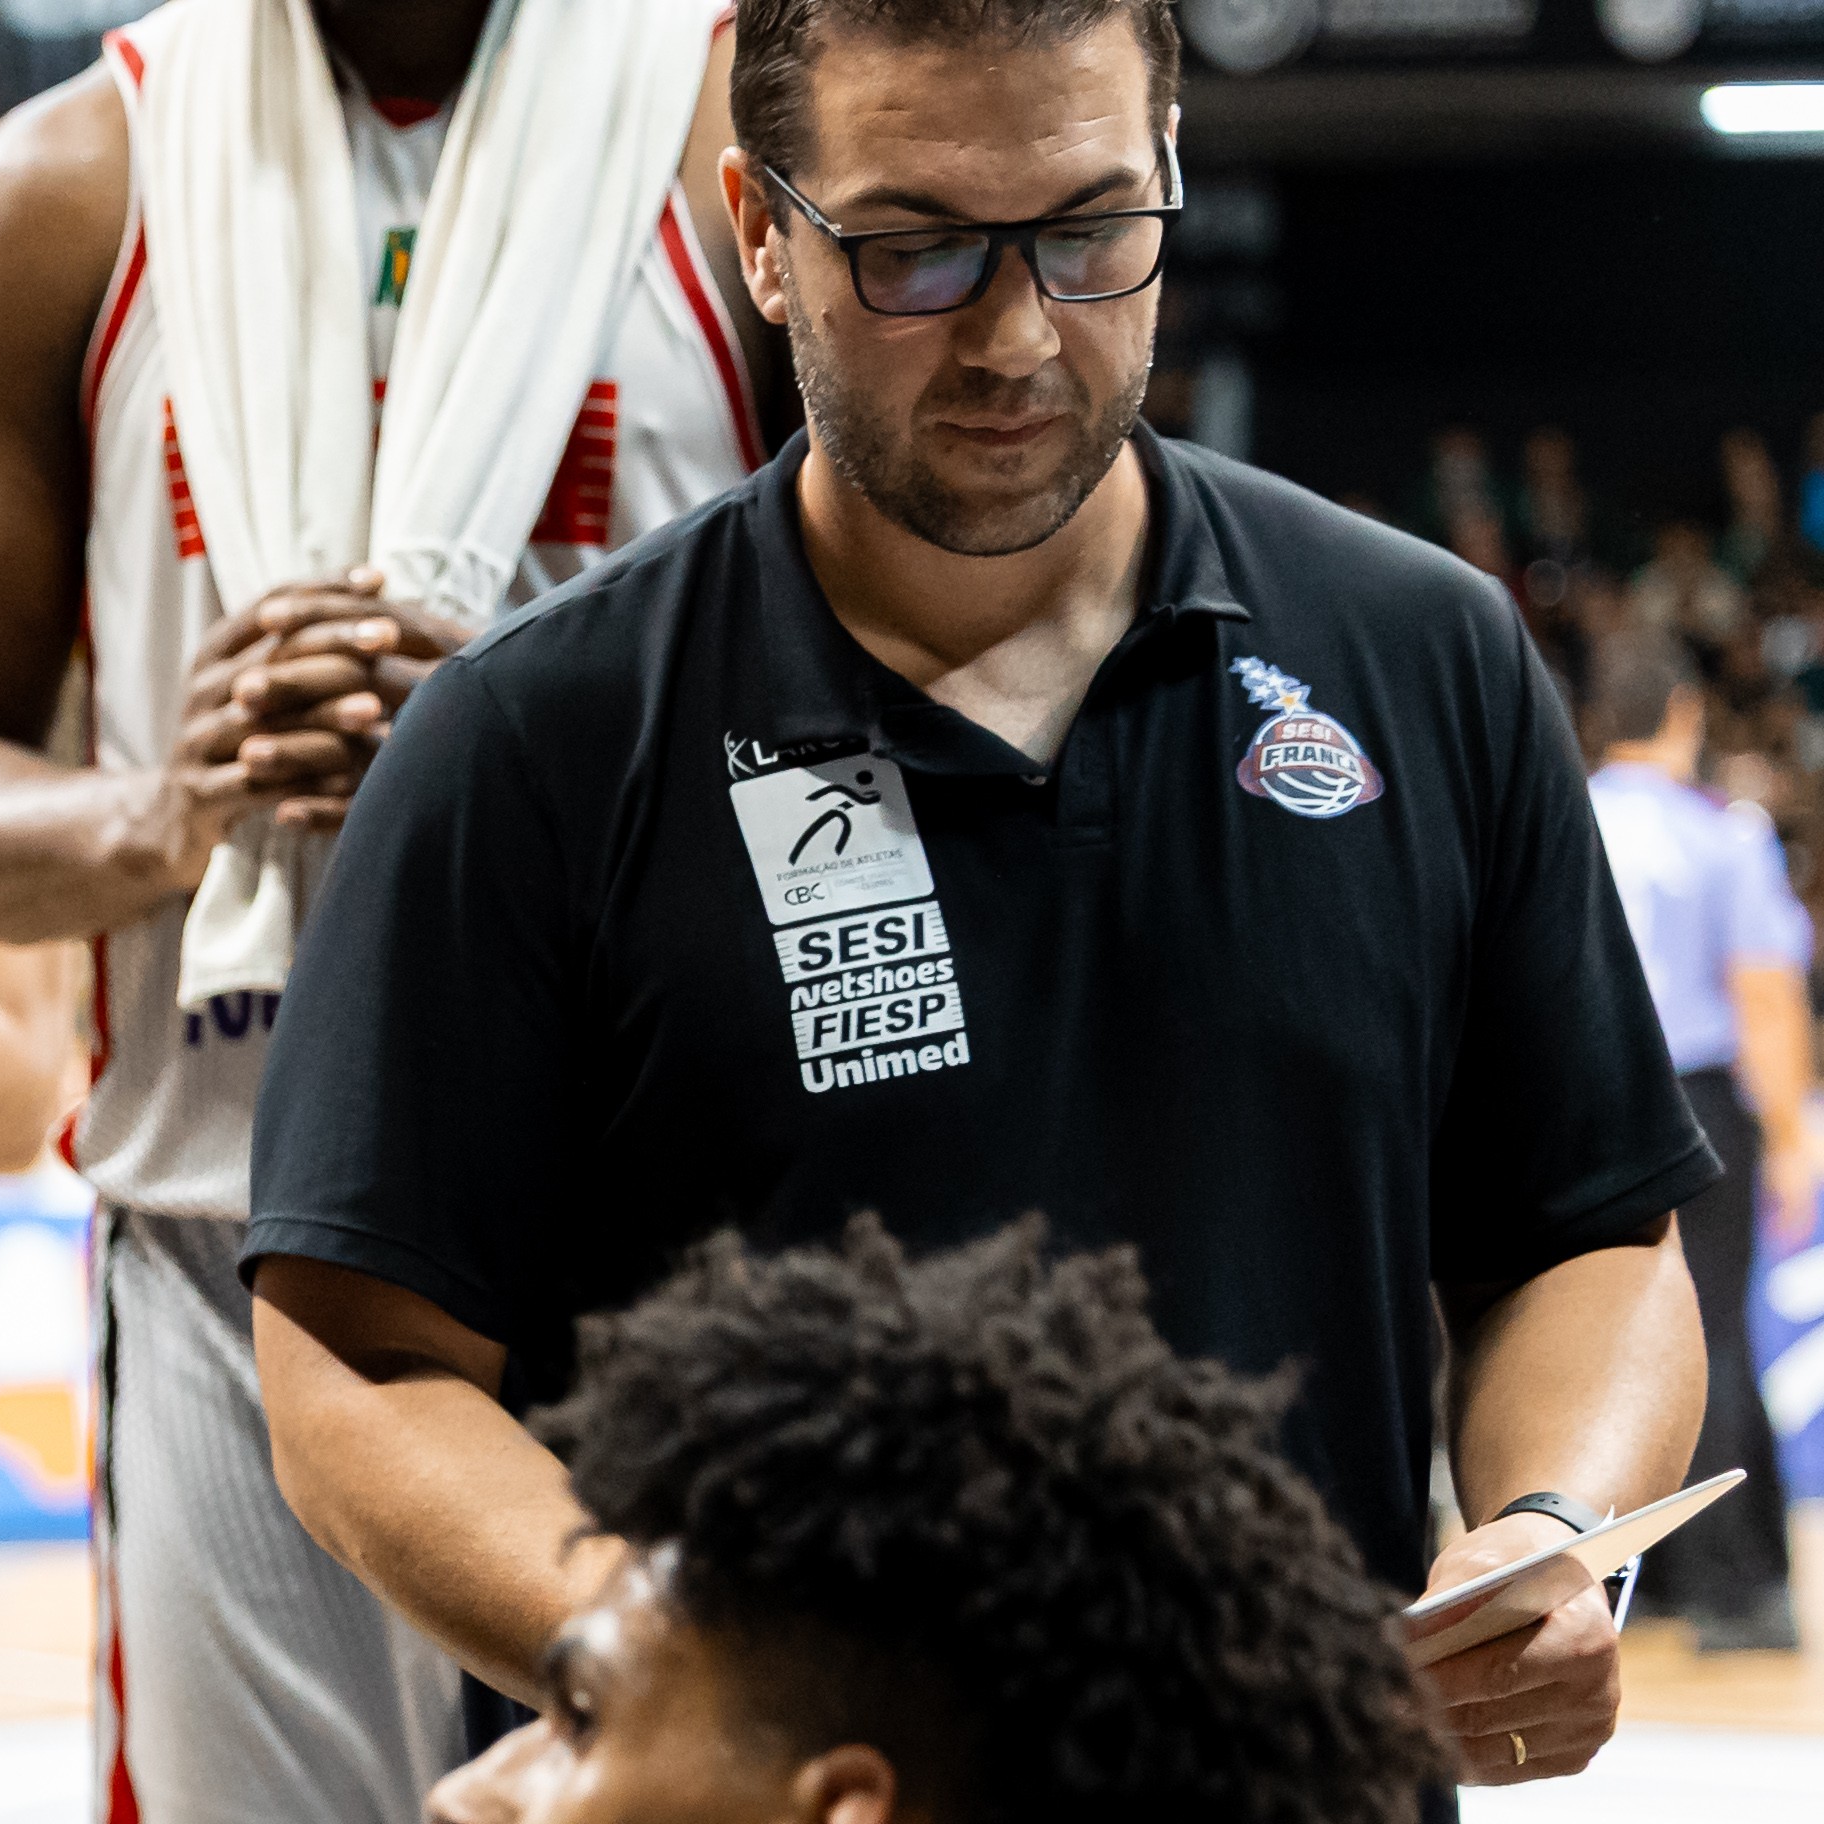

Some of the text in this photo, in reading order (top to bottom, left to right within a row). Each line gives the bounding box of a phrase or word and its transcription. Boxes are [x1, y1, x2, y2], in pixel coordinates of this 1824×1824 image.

[1281, 722, 1332, 741] SESI
[784, 881, 826, 906] CBC
[798, 911, 926, 972] SESI
[811, 993, 946, 1050] FIESP
[801, 1031, 970, 1093] Unimed
